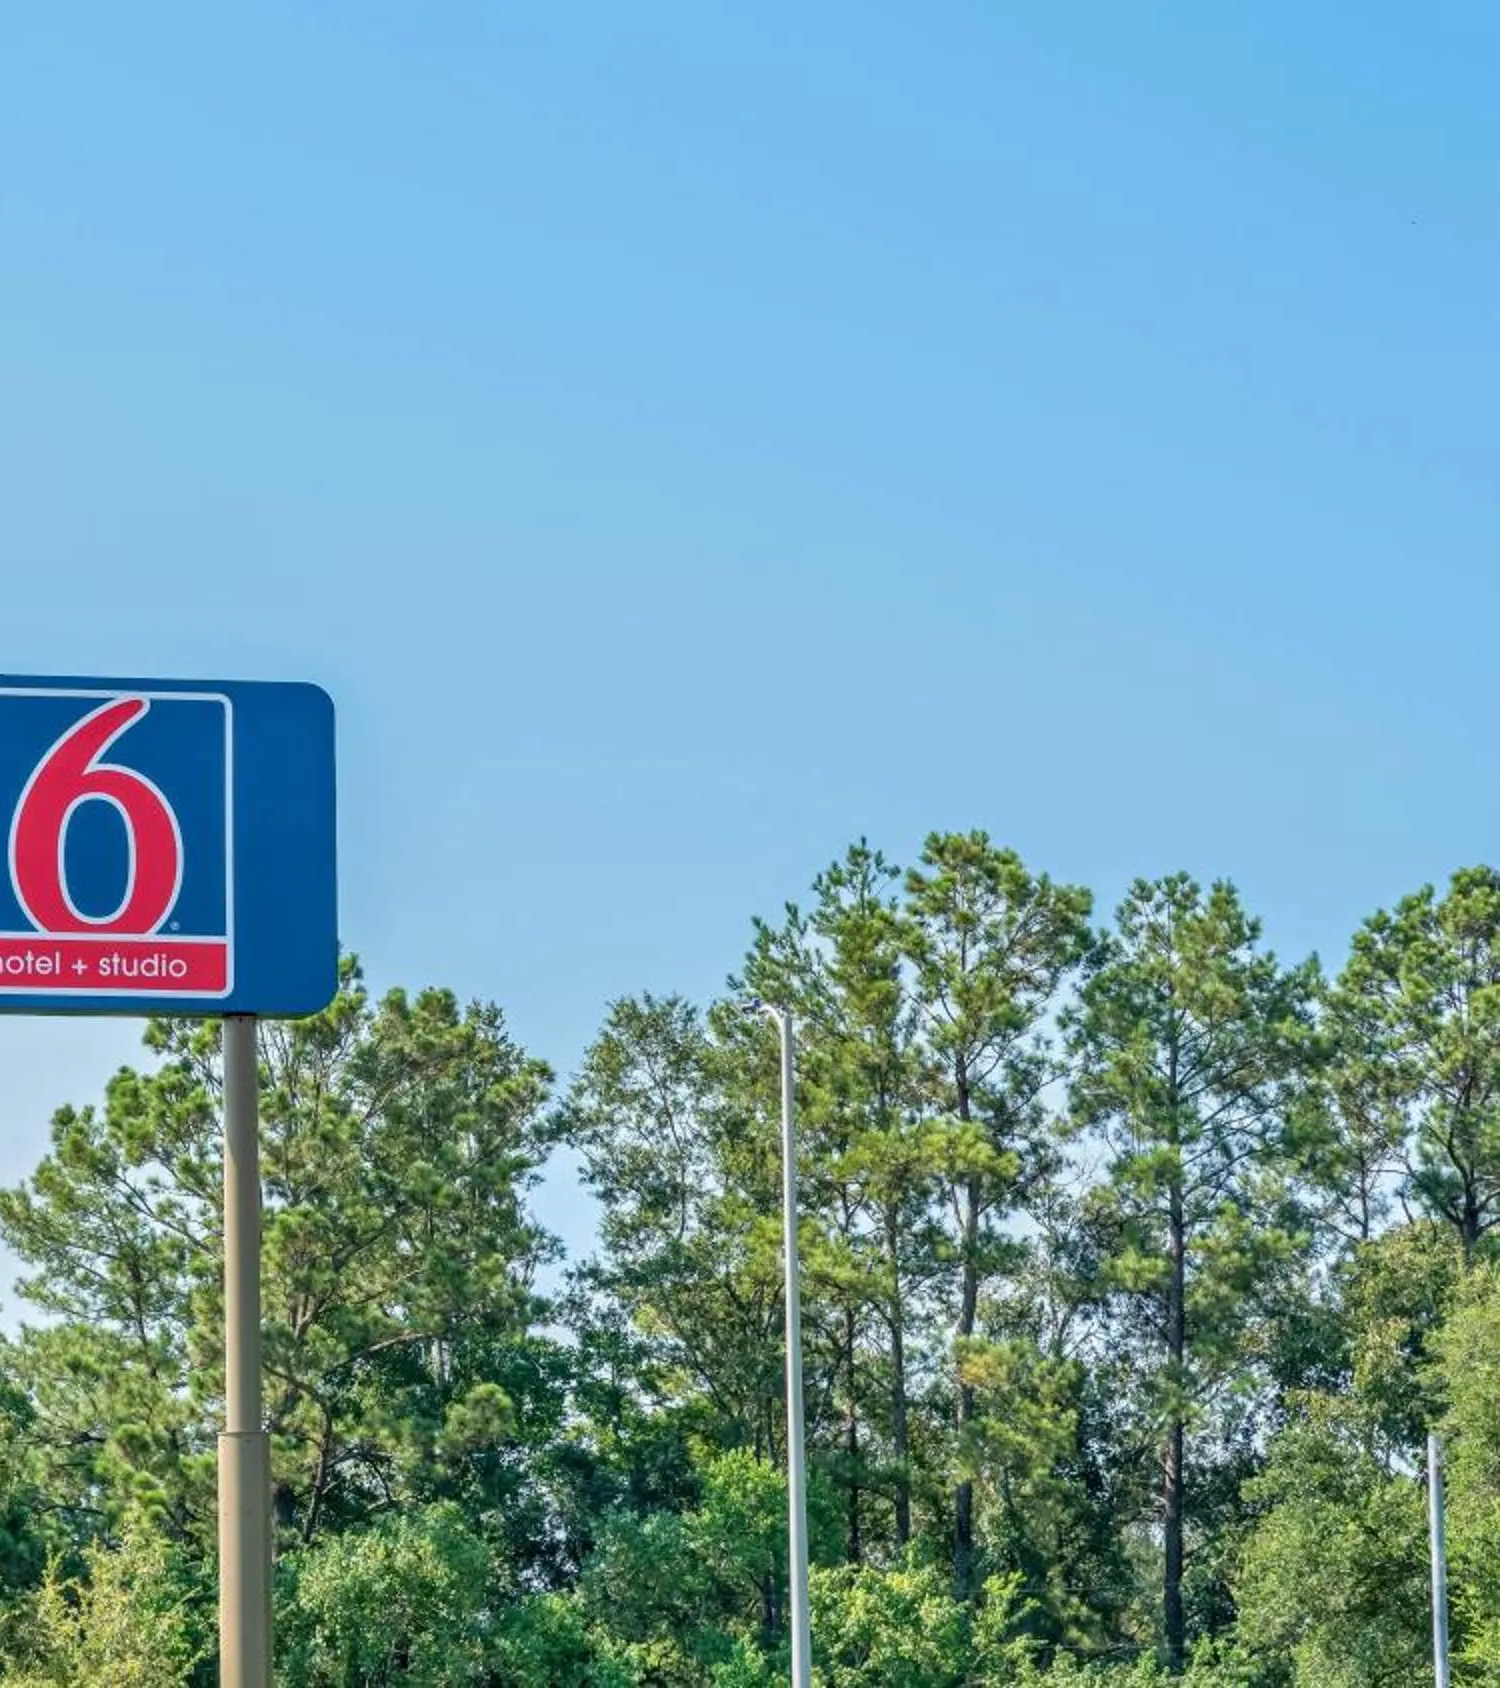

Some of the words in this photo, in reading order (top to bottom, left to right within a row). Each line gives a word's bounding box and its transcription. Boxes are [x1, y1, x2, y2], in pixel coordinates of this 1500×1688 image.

[7, 694, 184, 936] 6
[71, 958, 88, 975] +
[98, 952, 188, 978] studio
